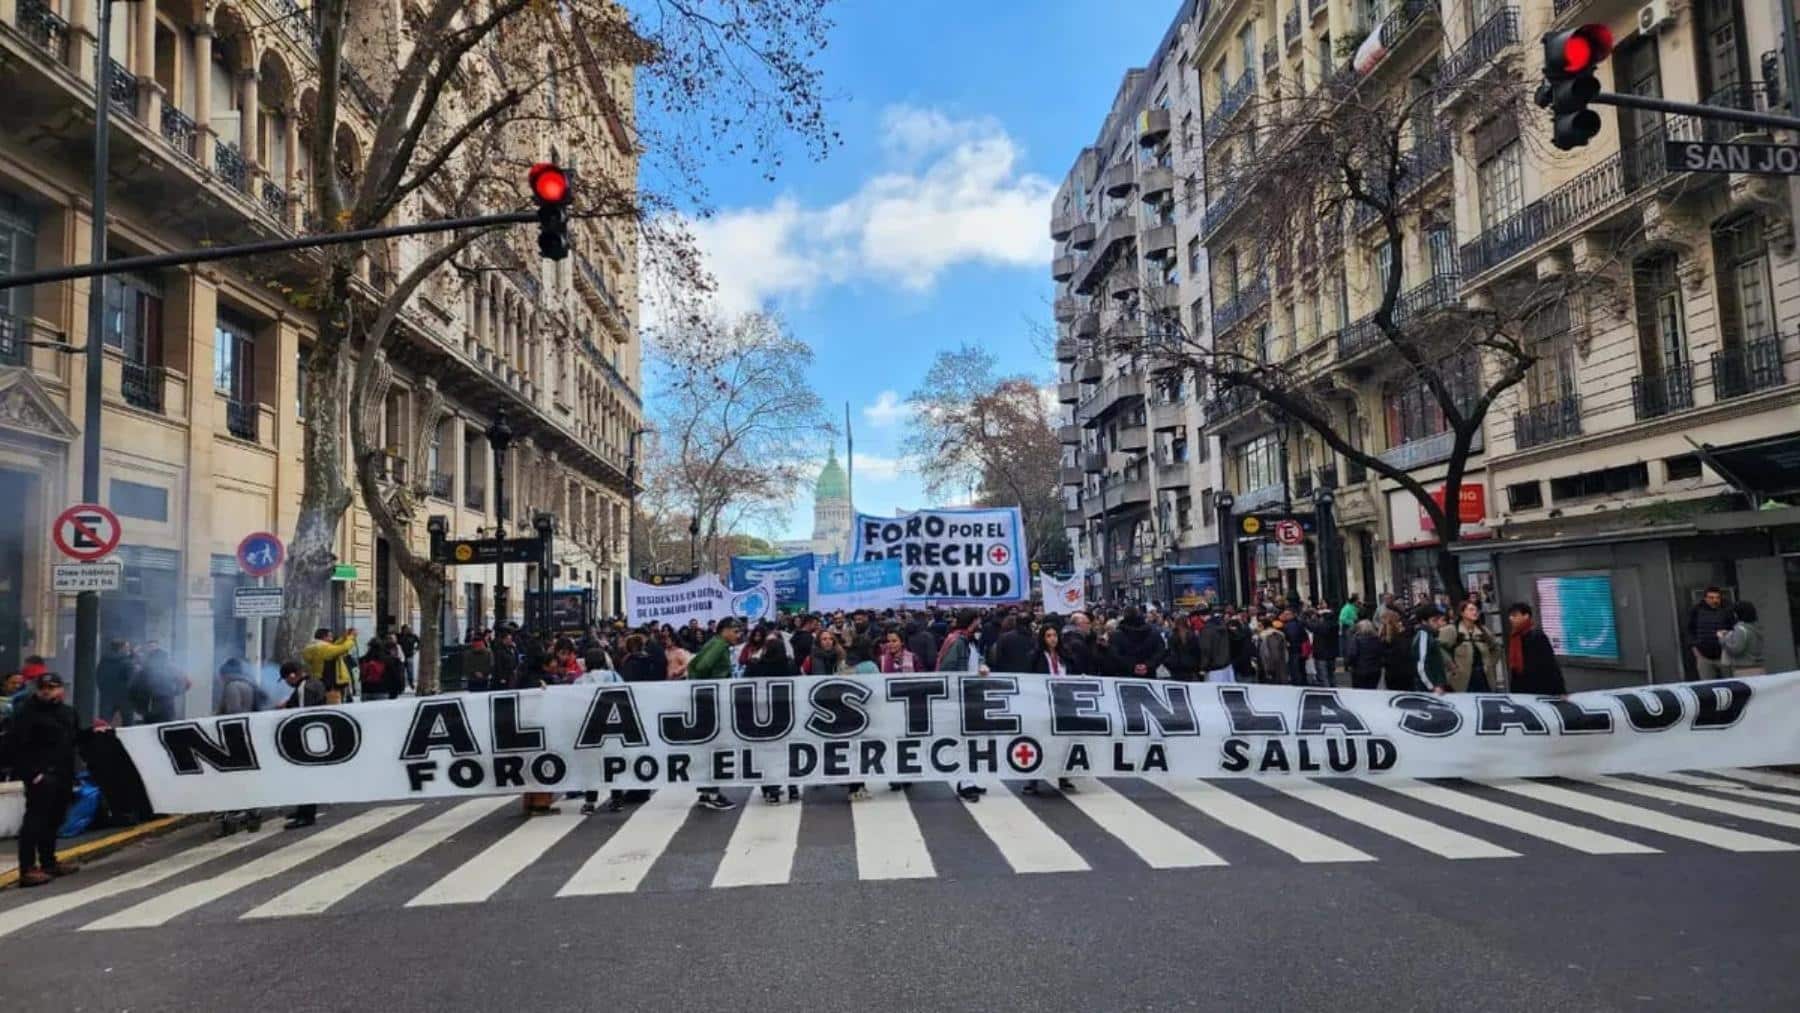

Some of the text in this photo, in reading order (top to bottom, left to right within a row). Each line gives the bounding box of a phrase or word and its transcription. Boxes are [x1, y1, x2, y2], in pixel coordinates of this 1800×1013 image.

[1685, 144, 1800, 172] SAN JO
[864, 515, 1005, 545] FORO POR EL
[908, 572, 1011, 597] SALUD
[636, 608, 648, 619] DE
[649, 606, 659, 618] LA
[660, 603, 687, 616] SALUD
[158, 676, 1757, 776] NO AL AJUSTE EN LA SALUD
[406, 735, 1398, 791] FORO POR EL DERECHO A LA SALUD
